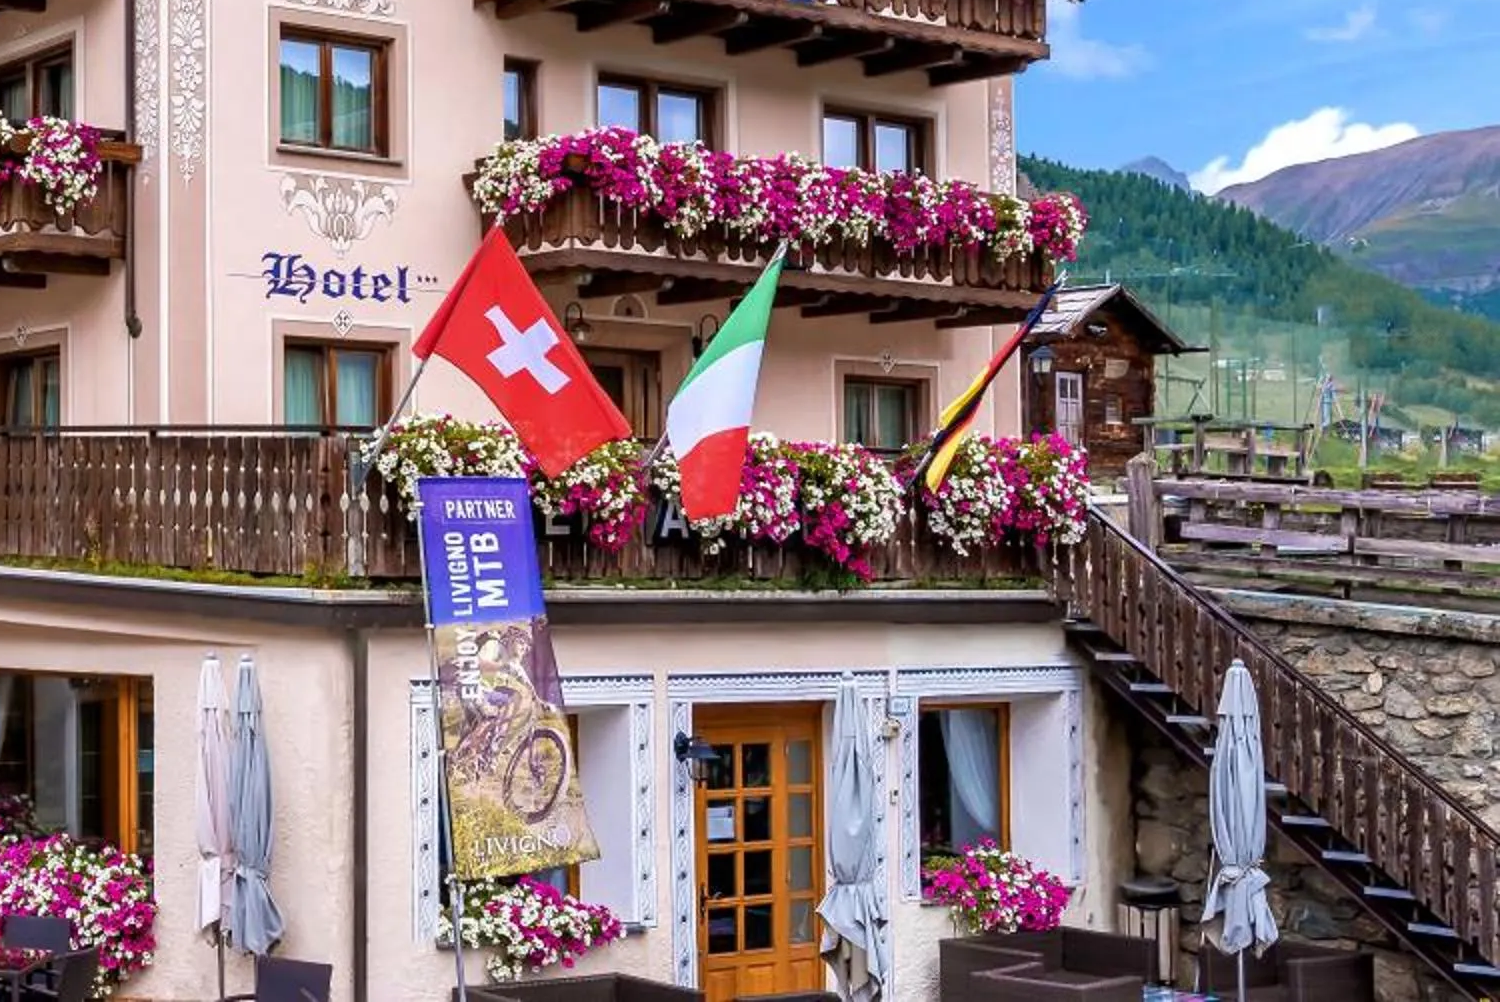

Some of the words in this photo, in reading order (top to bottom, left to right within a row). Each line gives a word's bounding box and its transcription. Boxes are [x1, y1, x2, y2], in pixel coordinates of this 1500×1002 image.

[261, 253, 411, 304] Hotel
[444, 500, 517, 520] PARTNER
[444, 531, 474, 617] LIVIGNO
[470, 532, 509, 608] MTB
[455, 627, 483, 702] ENJOY
[474, 823, 571, 857] LIVIGNO
